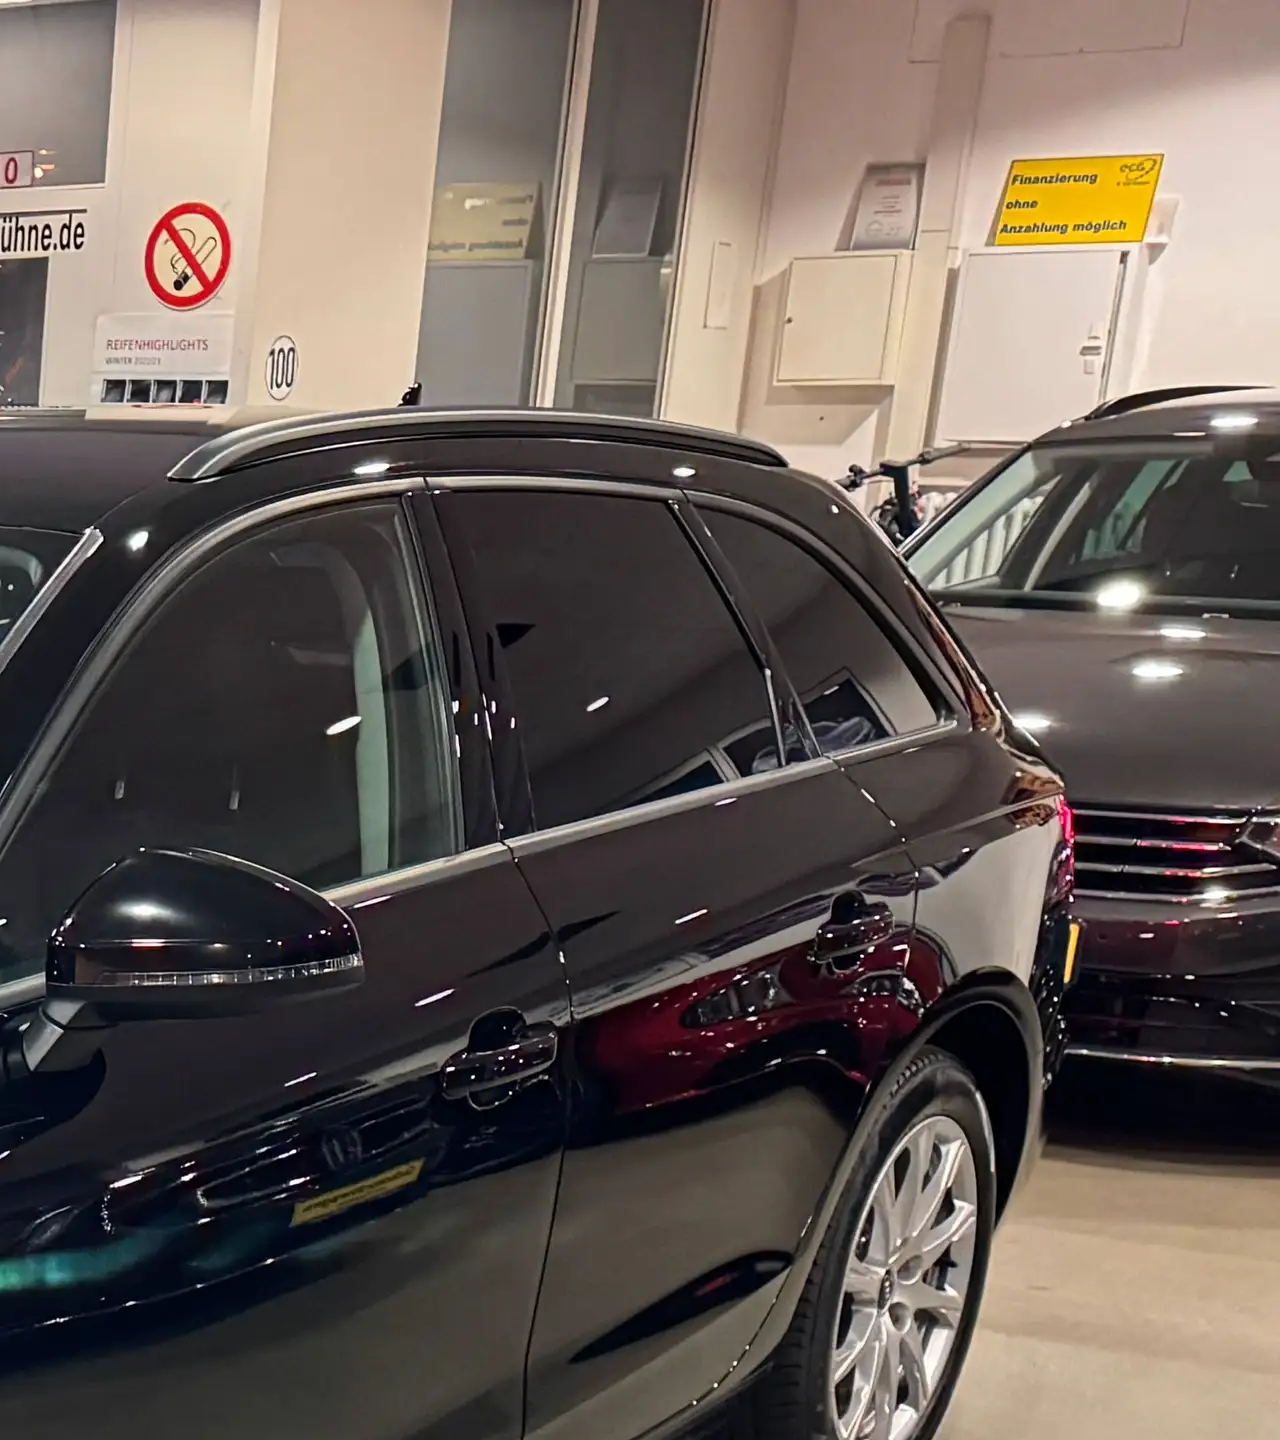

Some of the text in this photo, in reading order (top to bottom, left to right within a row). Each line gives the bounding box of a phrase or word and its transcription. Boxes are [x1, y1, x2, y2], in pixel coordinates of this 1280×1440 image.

[1011, 173, 1098, 187] Finanzierung
[1006, 199, 1038, 210] ohne
[1000, 220, 1127, 235] Anzahlung möglich
[106, 339, 209, 351] REIFENHIGHLIGHTS
[269, 347, 297, 390] 100
